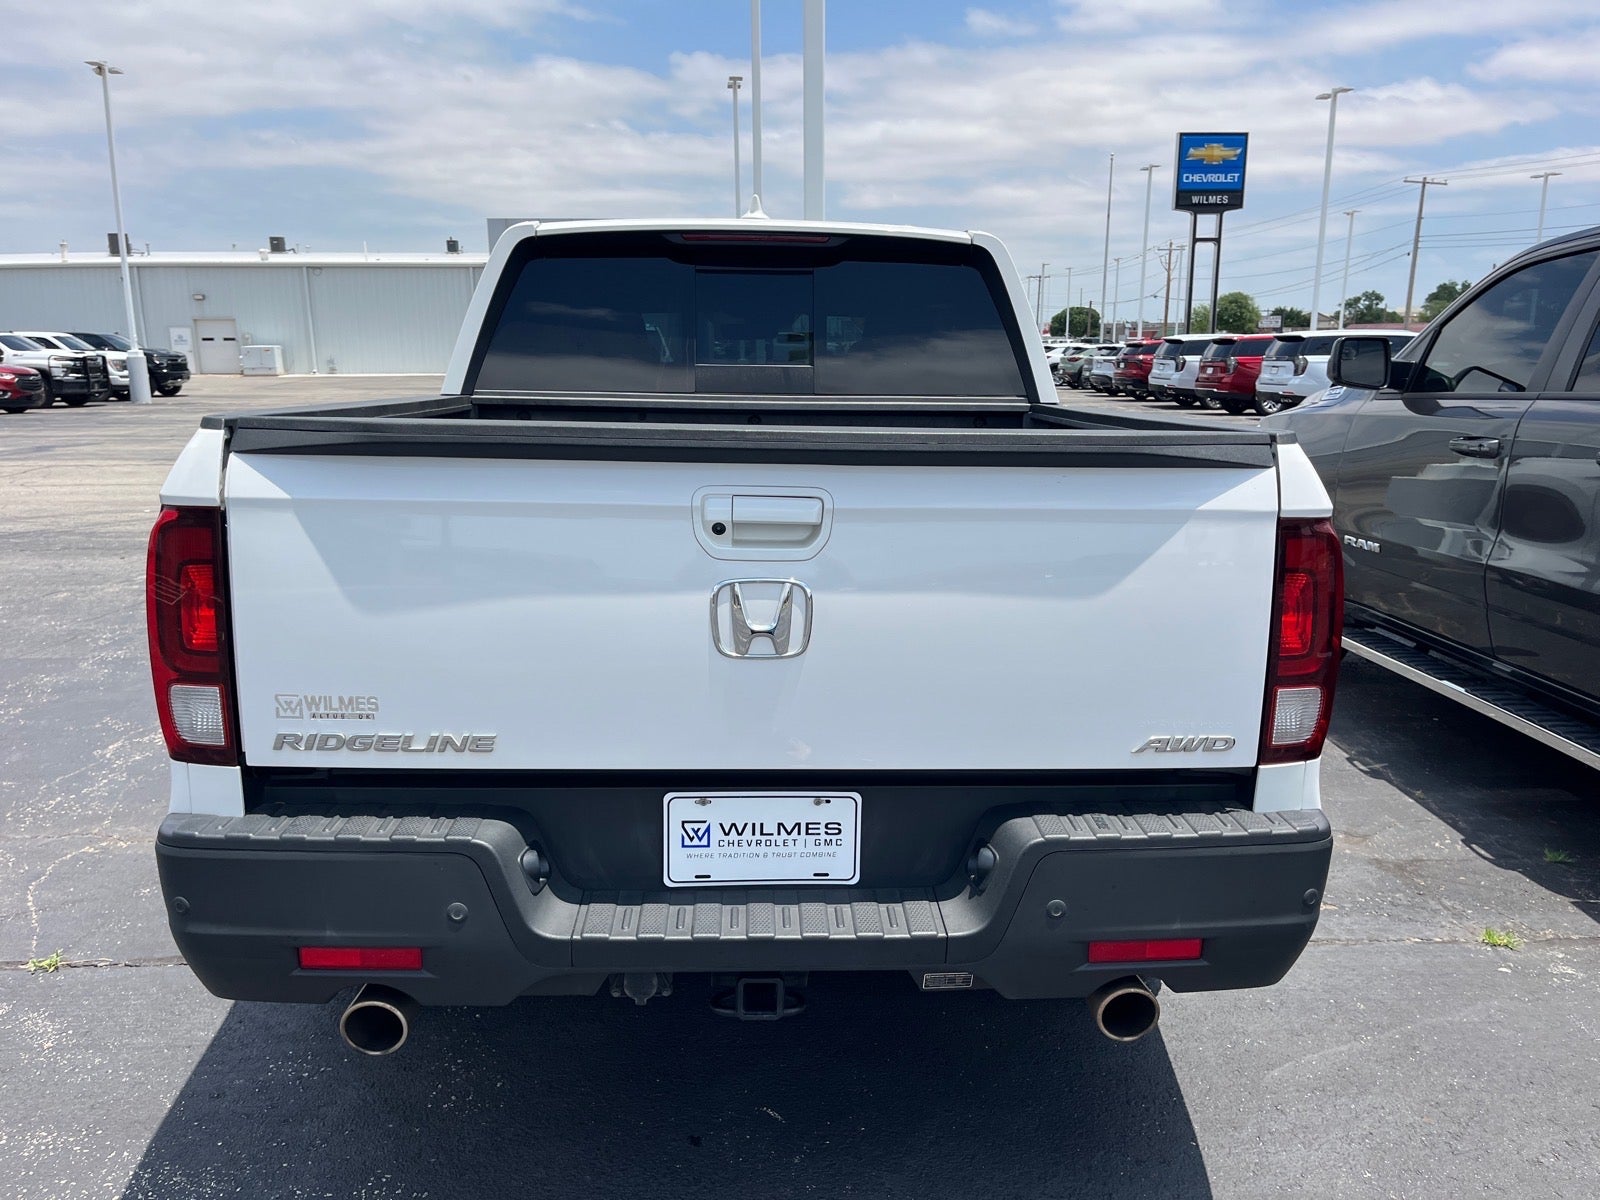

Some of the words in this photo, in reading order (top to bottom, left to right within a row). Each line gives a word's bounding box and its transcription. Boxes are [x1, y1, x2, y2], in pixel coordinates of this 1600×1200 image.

[1183, 173, 1240, 183] CHEVROLET
[1191, 195, 1229, 204] WILMES
[1343, 534, 1381, 553] RAM
[303, 694, 380, 712] WILMES
[311, 712, 346, 720] ALTUS
[272, 732, 498, 753] RIDGELINE
[1130, 735, 1236, 753] AWD
[718, 821, 843, 837] WILMES
[717, 838, 799, 848] CHEVROLET
[814, 838, 843, 847] GMC
